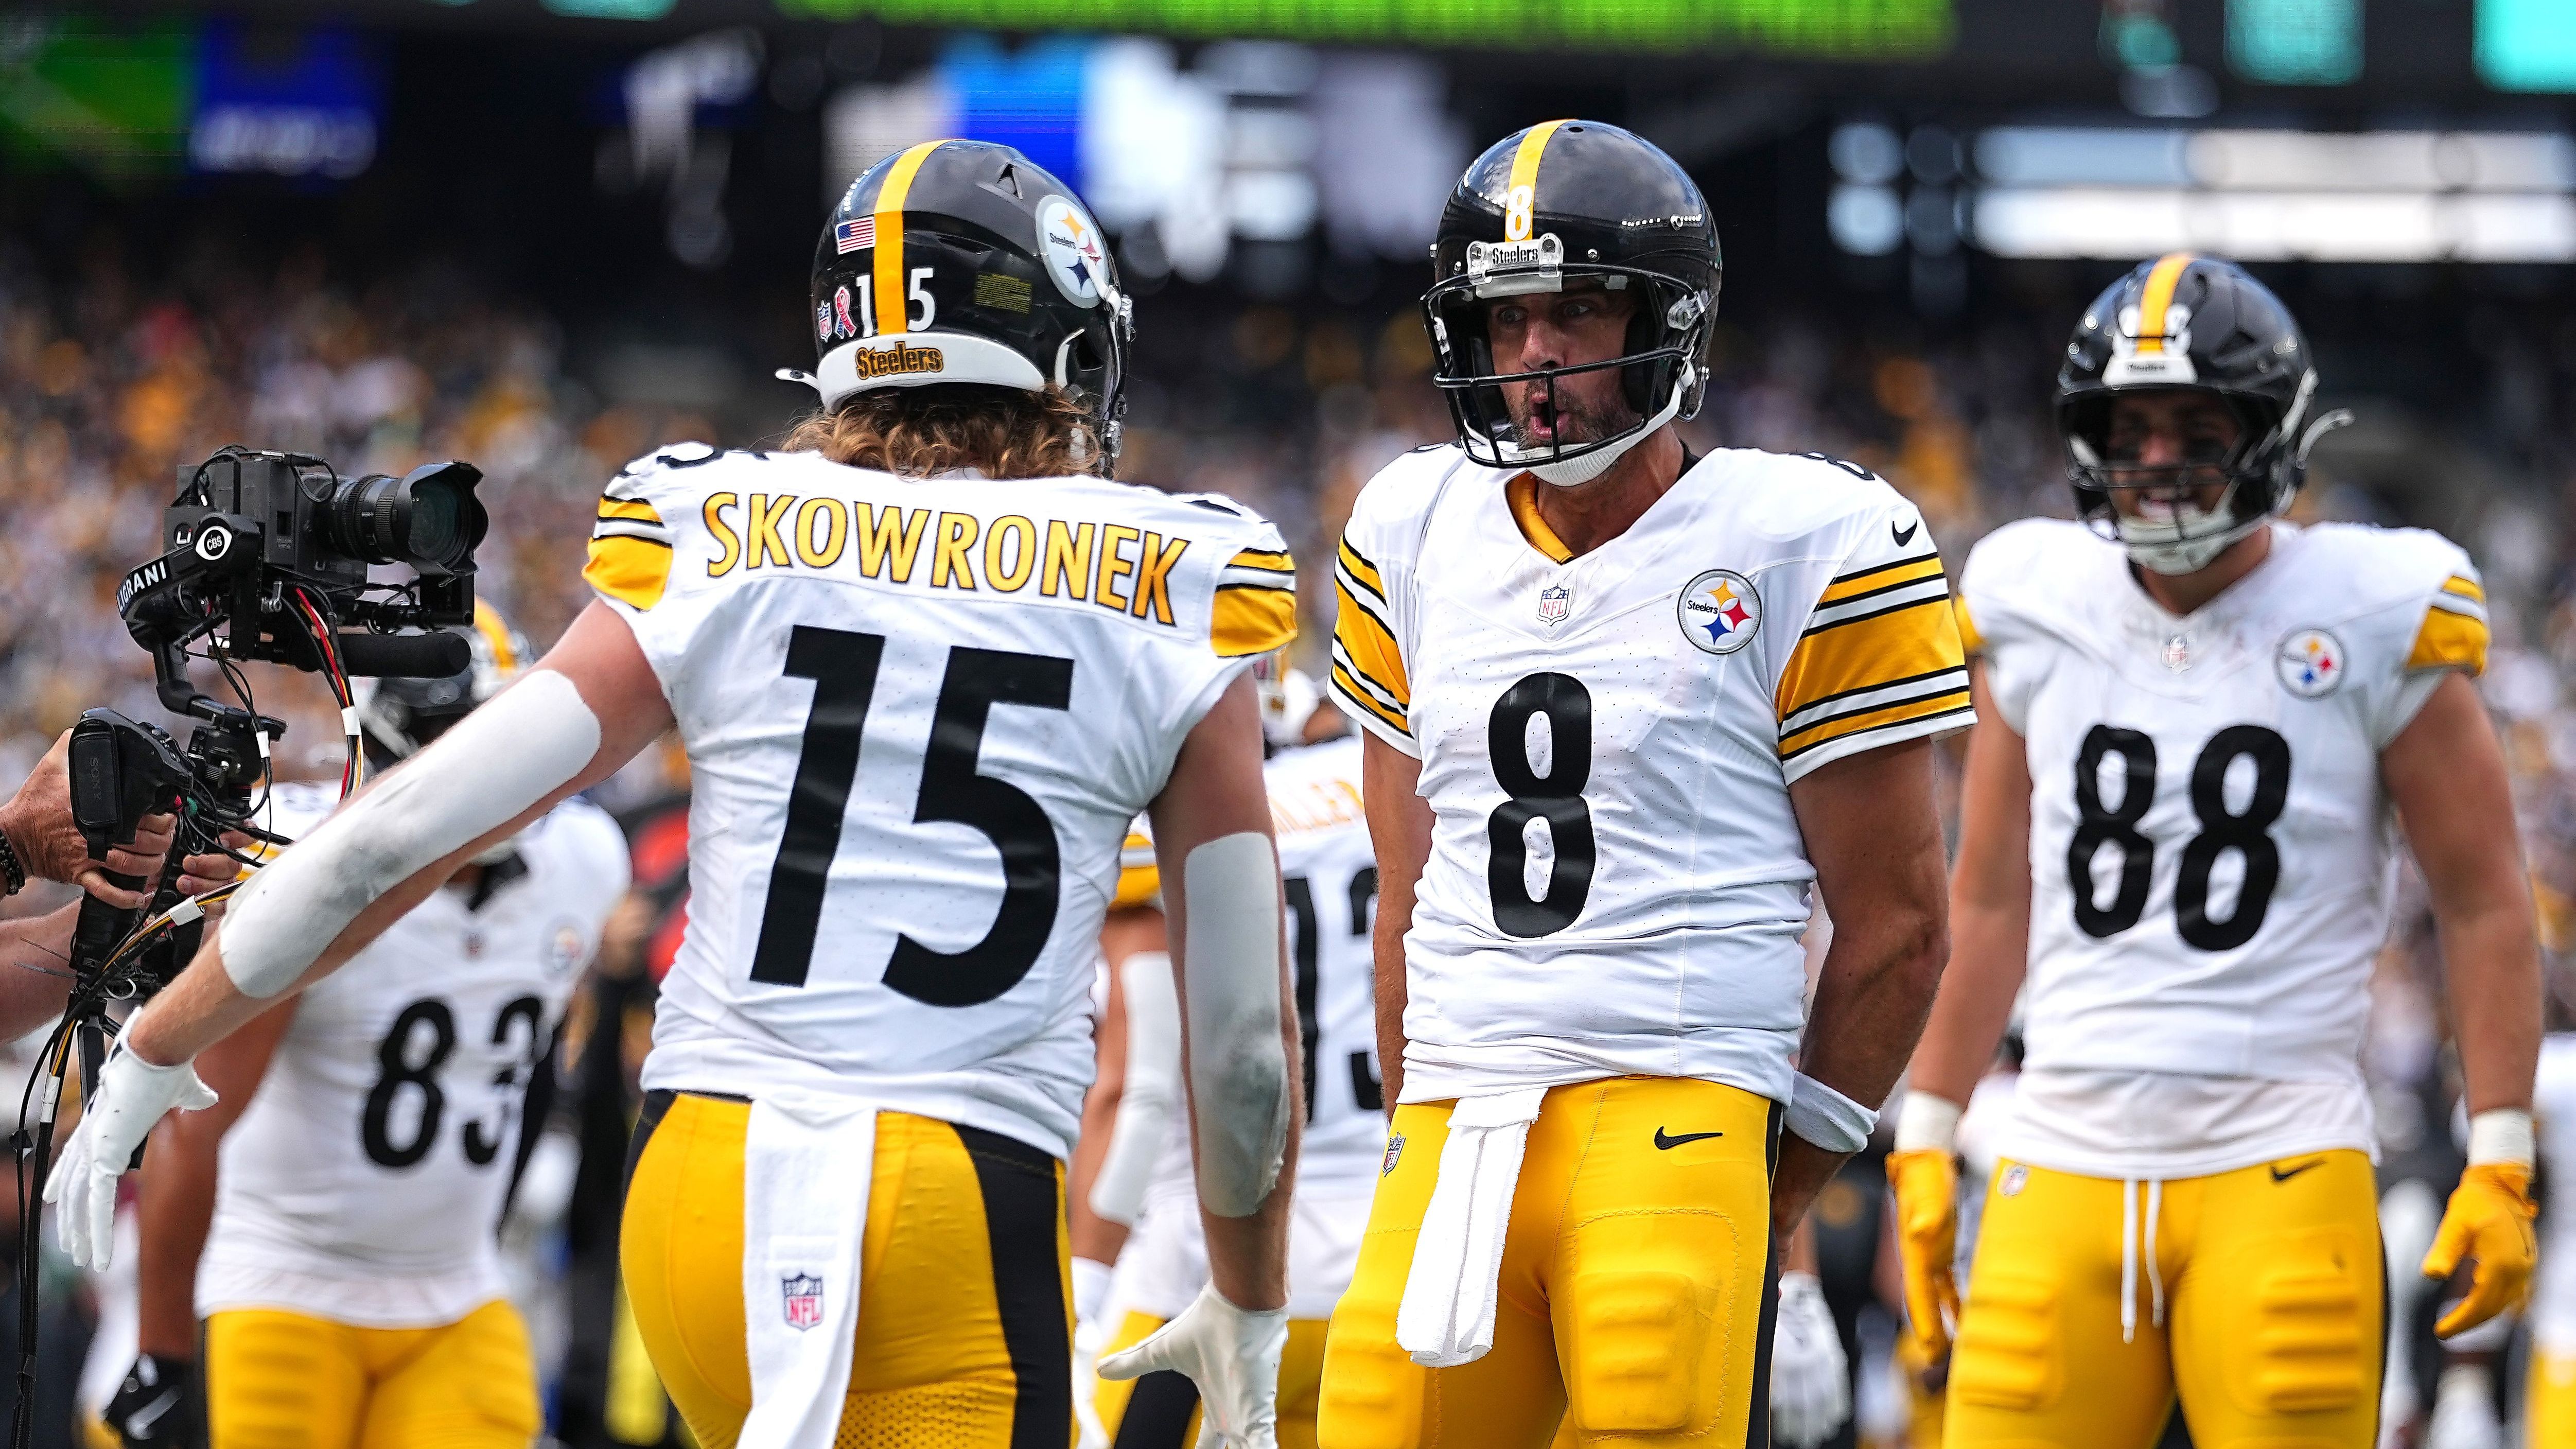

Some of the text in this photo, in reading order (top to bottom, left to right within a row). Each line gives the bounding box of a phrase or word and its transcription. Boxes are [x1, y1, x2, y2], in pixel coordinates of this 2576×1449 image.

[1506, 185, 1532, 241] 8
[1492, 245, 1538, 265] Steelers
[855, 341, 943, 380] Steelers
[207, 535, 222, 550] CBS
[702, 492, 1190, 626] SKOWRONEK
[1541, 601, 1564, 616] NFL
[1687, 600, 1719, 614] Steelers
[750, 624, 1074, 1007] 15
[1488, 672, 1596, 938] 8
[2069, 725, 2289, 951] 88
[364, 997, 541, 1166] 83
[787, 1297, 820, 1326] NFL
